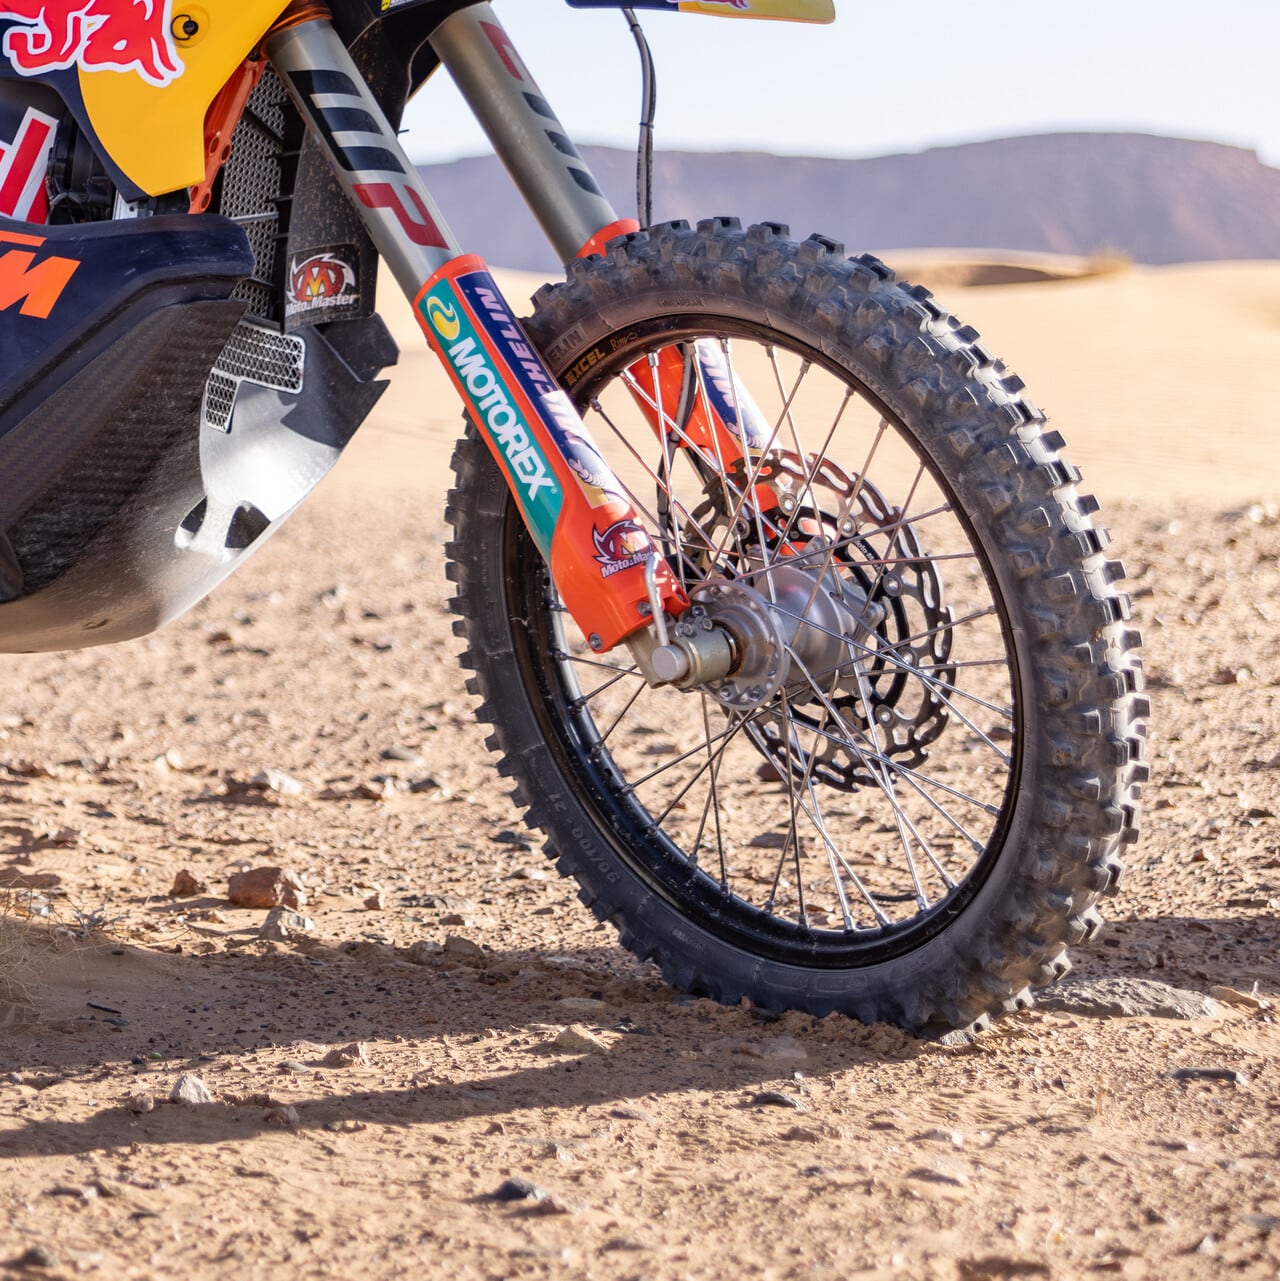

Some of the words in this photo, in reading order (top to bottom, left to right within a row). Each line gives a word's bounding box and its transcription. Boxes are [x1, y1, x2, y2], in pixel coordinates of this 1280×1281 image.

[565, 347, 607, 386] EXCEL
[448, 336, 556, 502] MOTOREX
[600, 552, 652, 579] Moto-Ma
